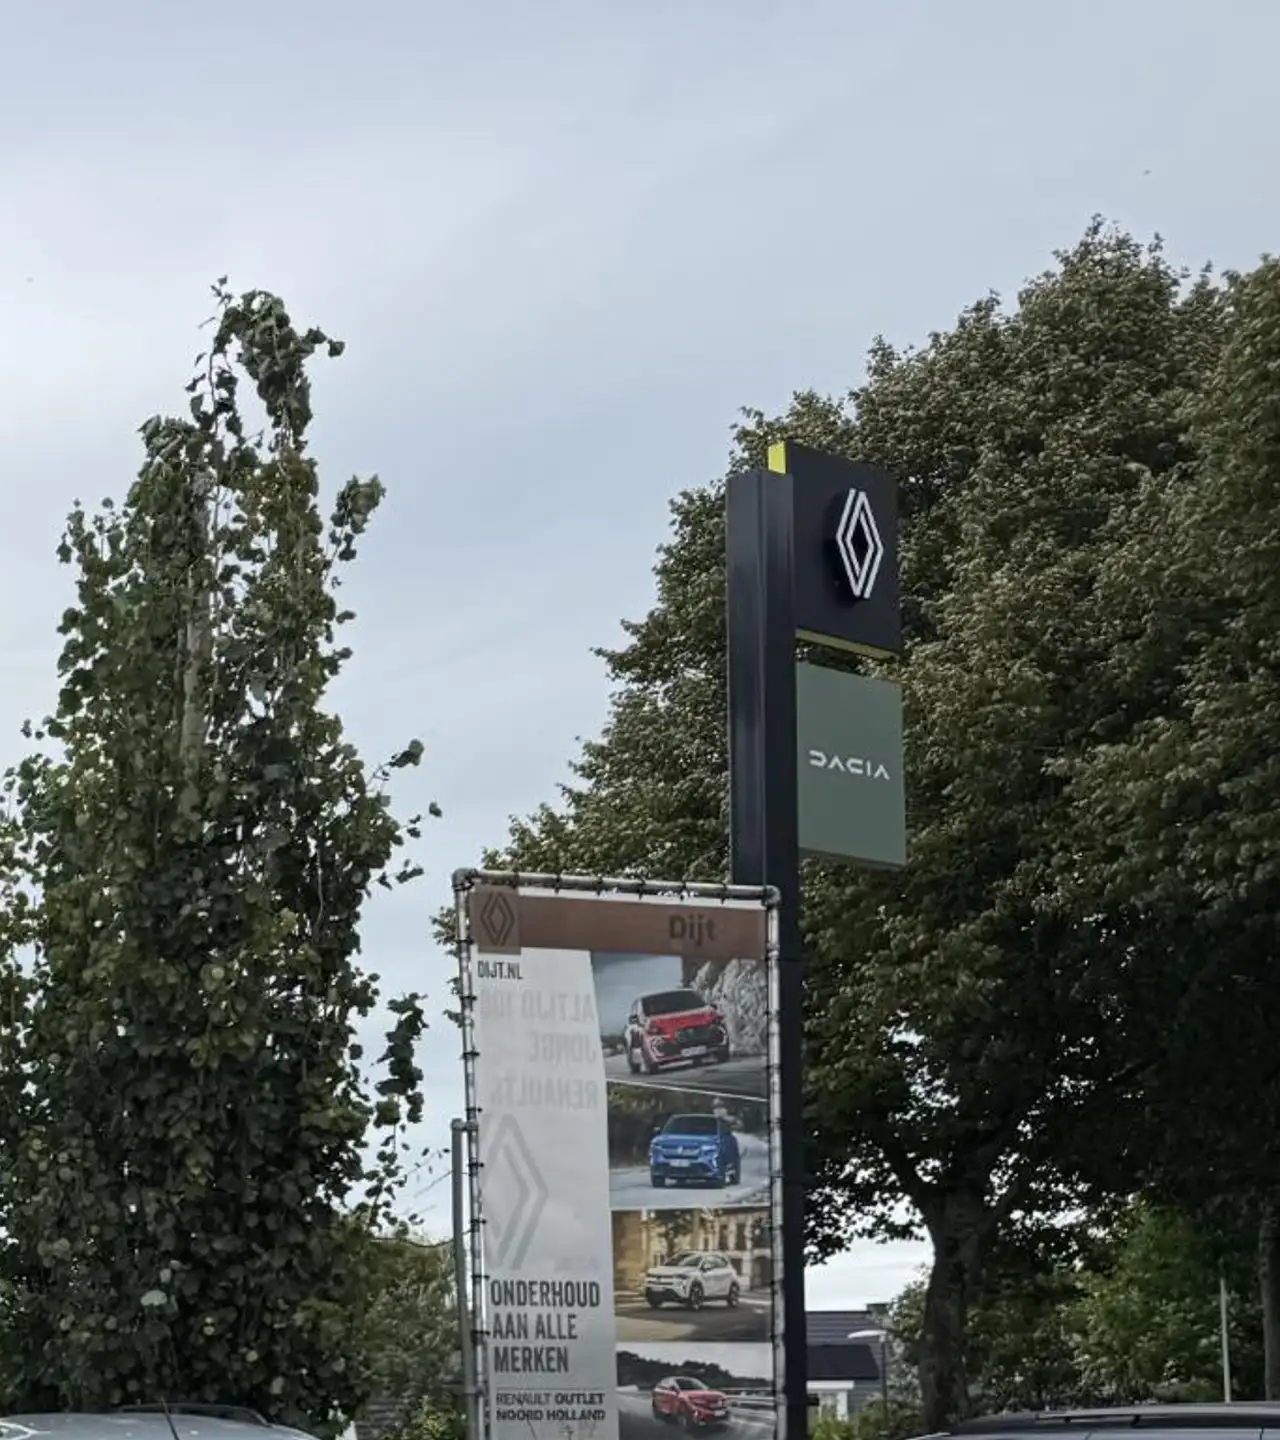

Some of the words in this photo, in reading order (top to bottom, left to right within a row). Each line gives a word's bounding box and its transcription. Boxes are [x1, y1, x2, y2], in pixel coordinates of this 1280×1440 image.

[809, 749, 890, 781] DACIA
[668, 915, 716, 946] Dijt
[477, 961, 523, 980] DIJT.NL
[490, 1279, 600, 1308] ONDERHOUD
[493, 1313, 528, 1340] AAN
[535, 1313, 578, 1340] ALLE
[494, 1346, 569, 1373] MERKEN
[496, 1392, 551, 1405] RENAULT
[555, 1392, 605, 1405] OUTLET
[496, 1409, 543, 1421] NOORD
[547, 1409, 605, 1421] HOLLAND
